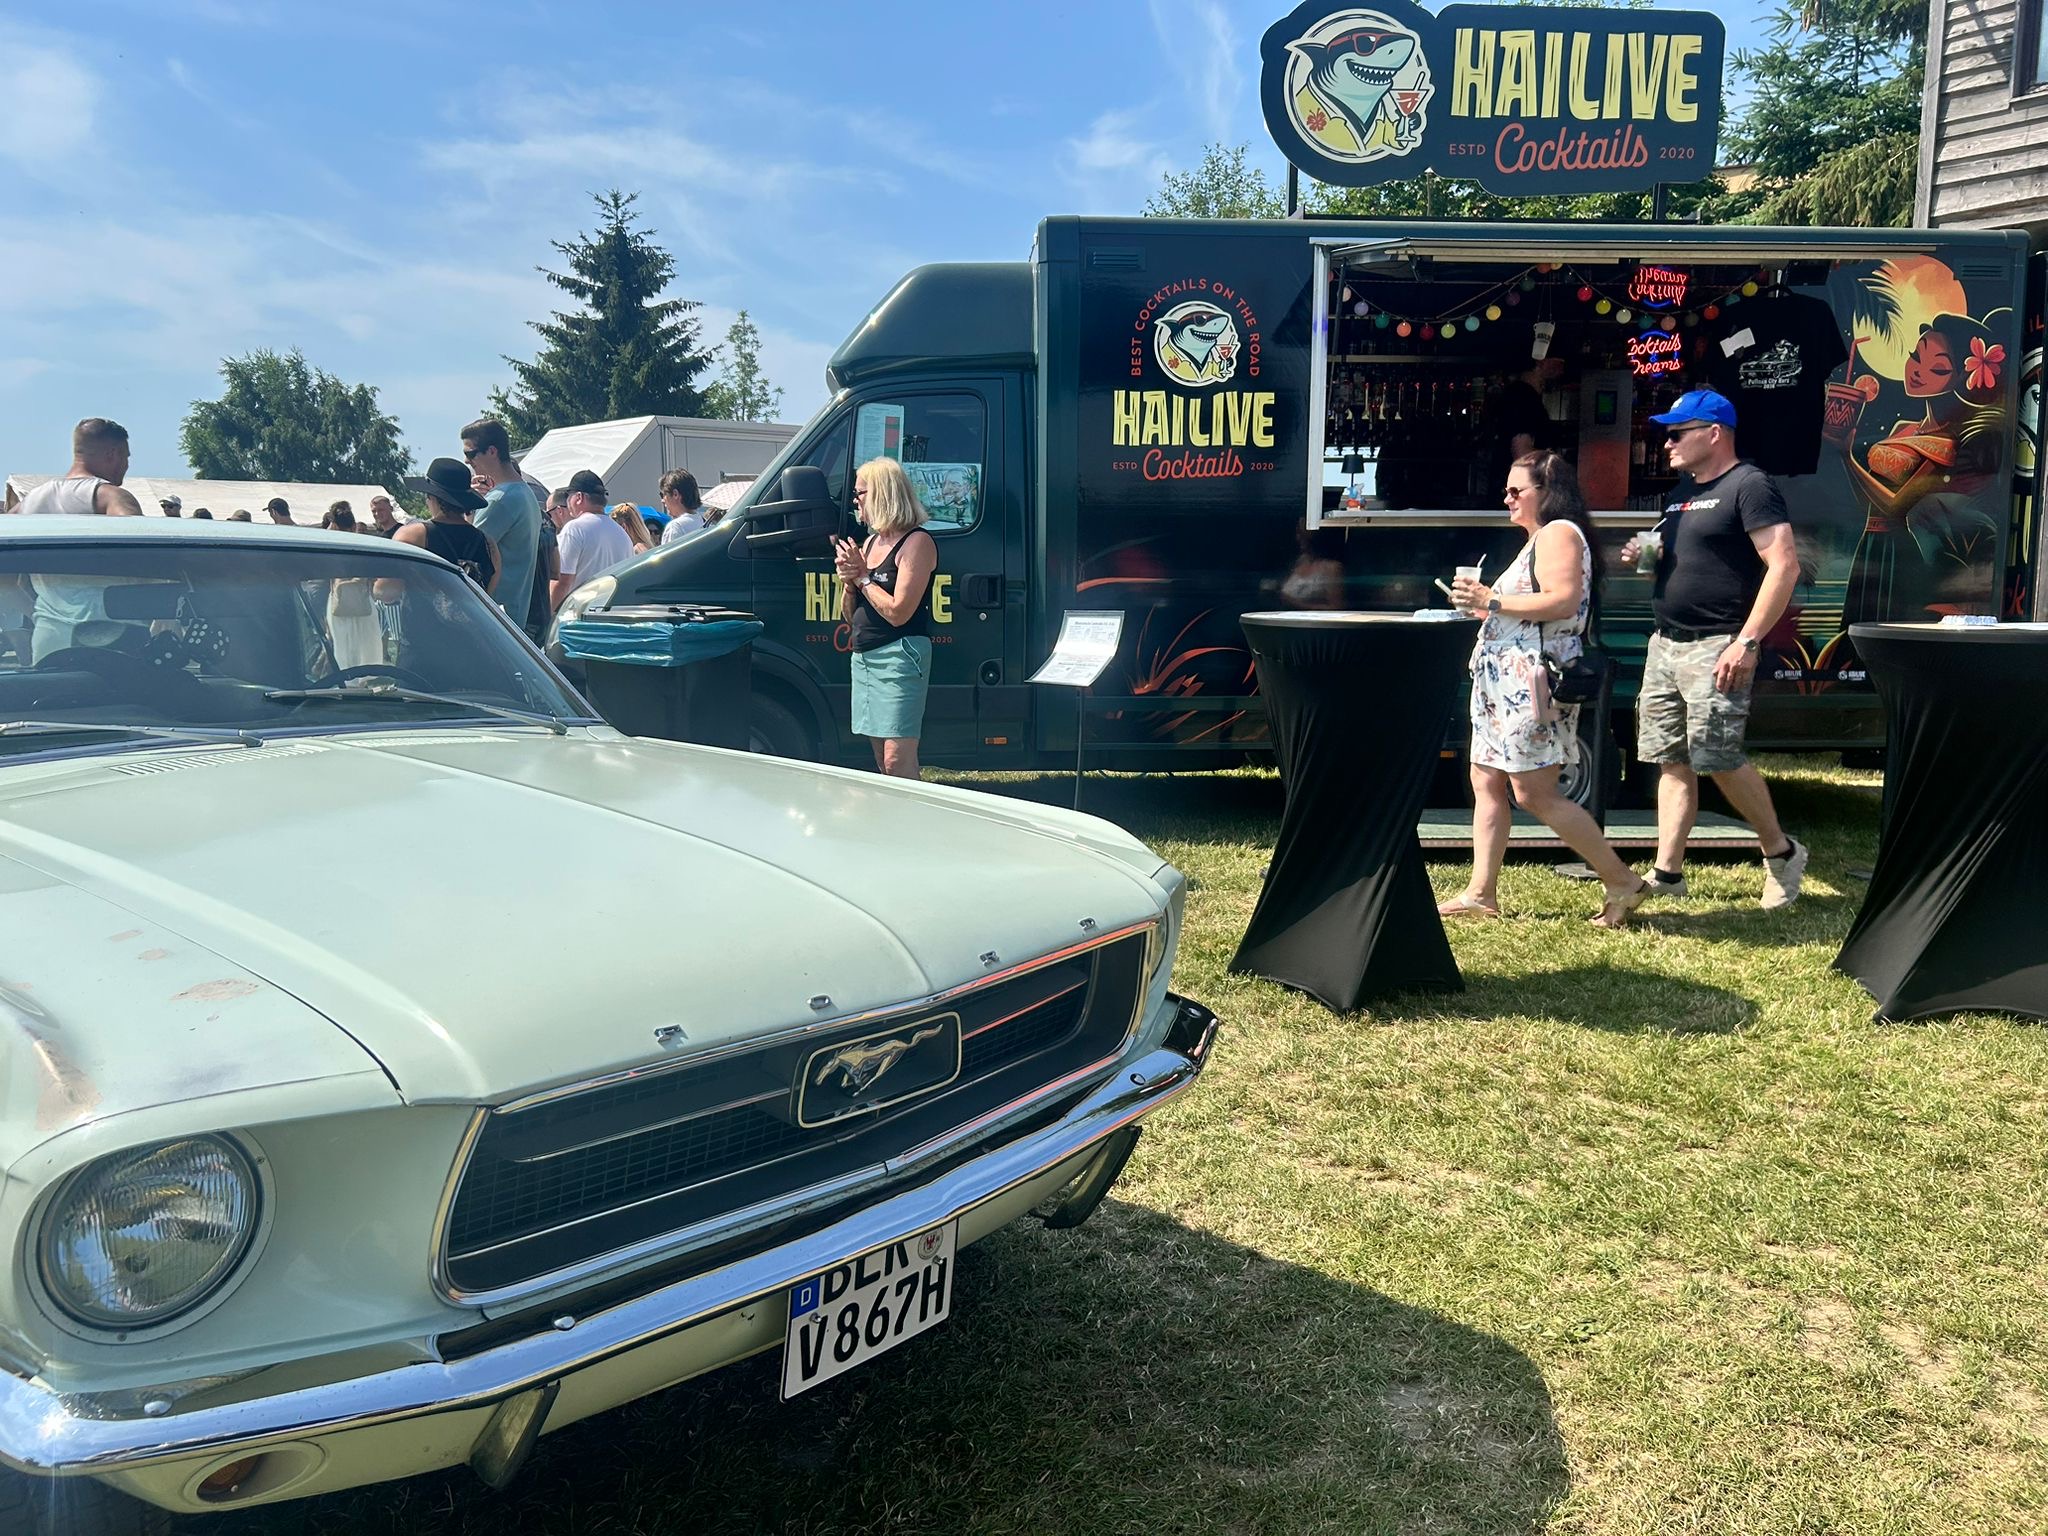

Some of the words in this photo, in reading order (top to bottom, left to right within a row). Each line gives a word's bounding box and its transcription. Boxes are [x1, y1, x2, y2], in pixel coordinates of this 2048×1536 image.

[1451, 28, 1702, 122] HAILIVE
[1449, 143, 1486, 156] ESTD
[1494, 122, 1649, 174] Cocktails
[1659, 146, 1695, 159] 2020
[1134, 278, 1207, 331] COCKTAILS
[1212, 282, 1235, 300] ON
[1235, 298, 1256, 328] THE
[1131, 337, 1142, 376] BEST
[1249, 332, 1261, 376] ROAD
[1112, 389, 1275, 448] HAILIVE
[1112, 462, 1138, 470] ESTD
[1143, 448, 1244, 481] Cocktails
[1250, 462, 1274, 470] 2020
[805, 634, 829, 642] ESTD
[800, 1287, 812, 1307] D
